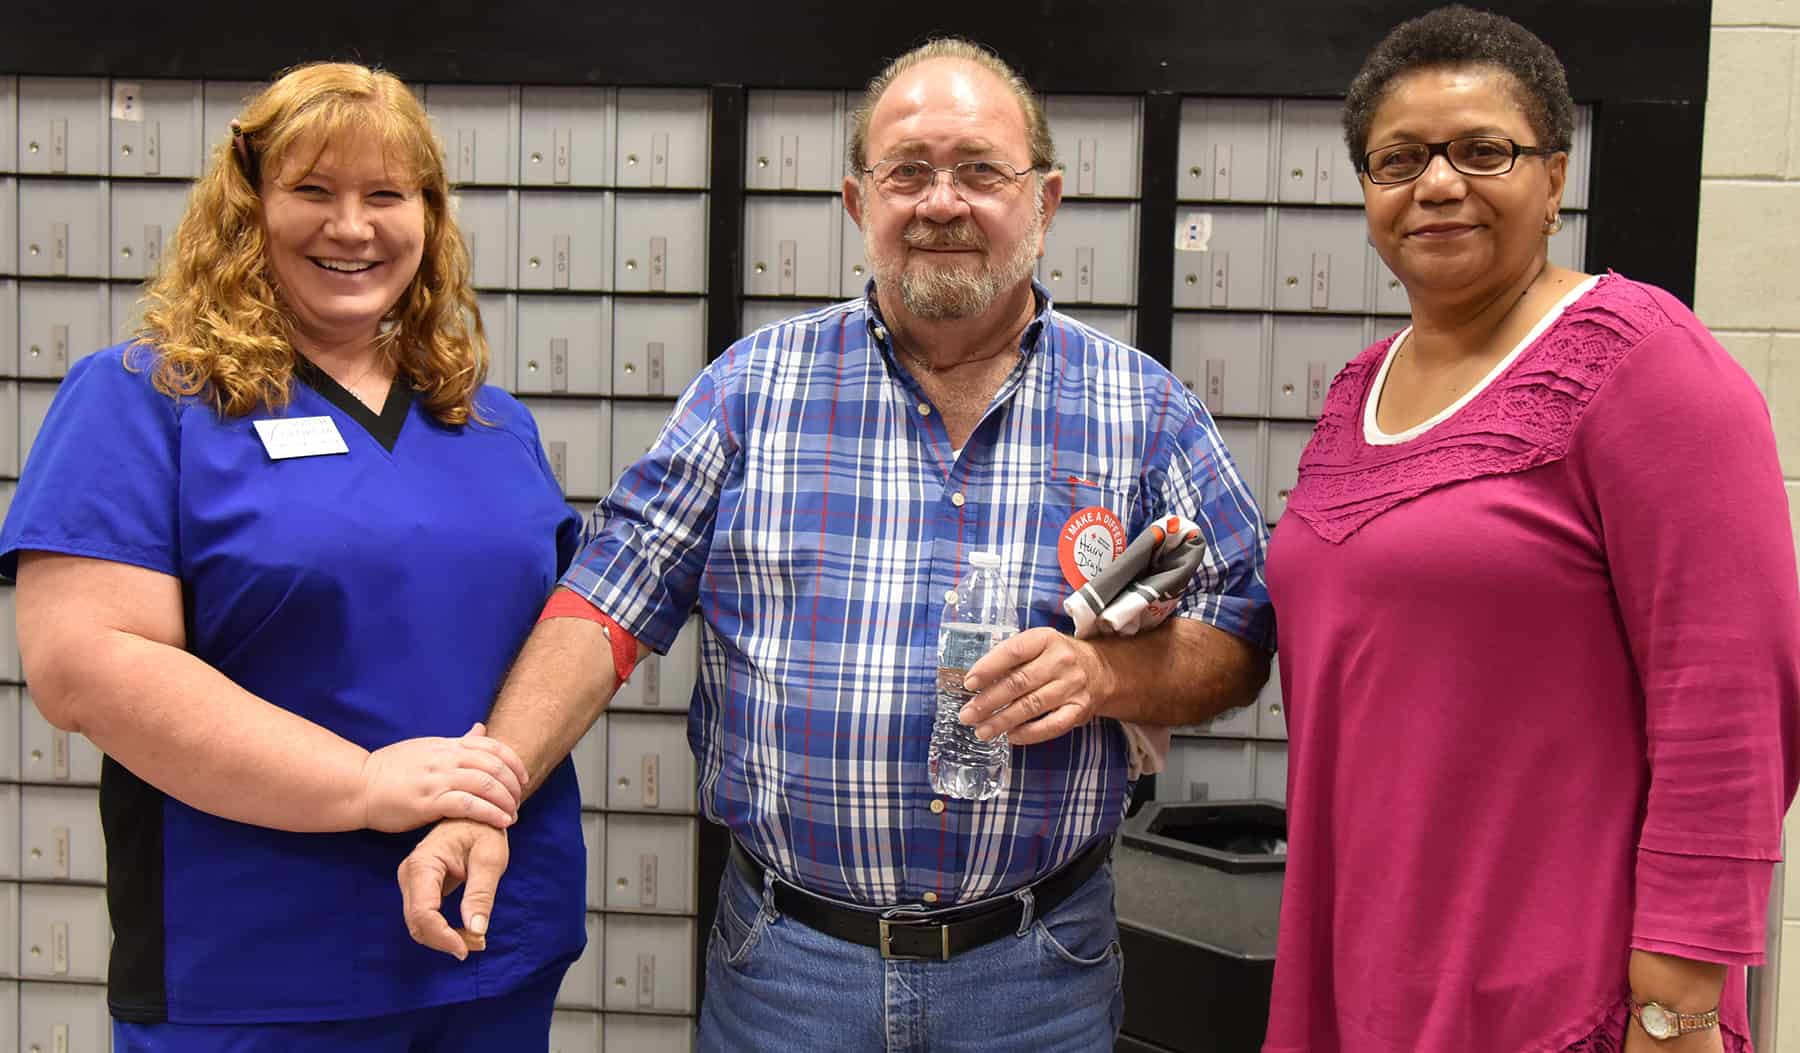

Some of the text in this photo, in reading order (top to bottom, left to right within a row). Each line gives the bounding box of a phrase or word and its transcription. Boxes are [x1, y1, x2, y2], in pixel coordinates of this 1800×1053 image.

[1068, 512, 1094, 535] MAKE
[1096, 511, 1102, 521] A
[1103, 514, 1124, 559] DIFFERE
